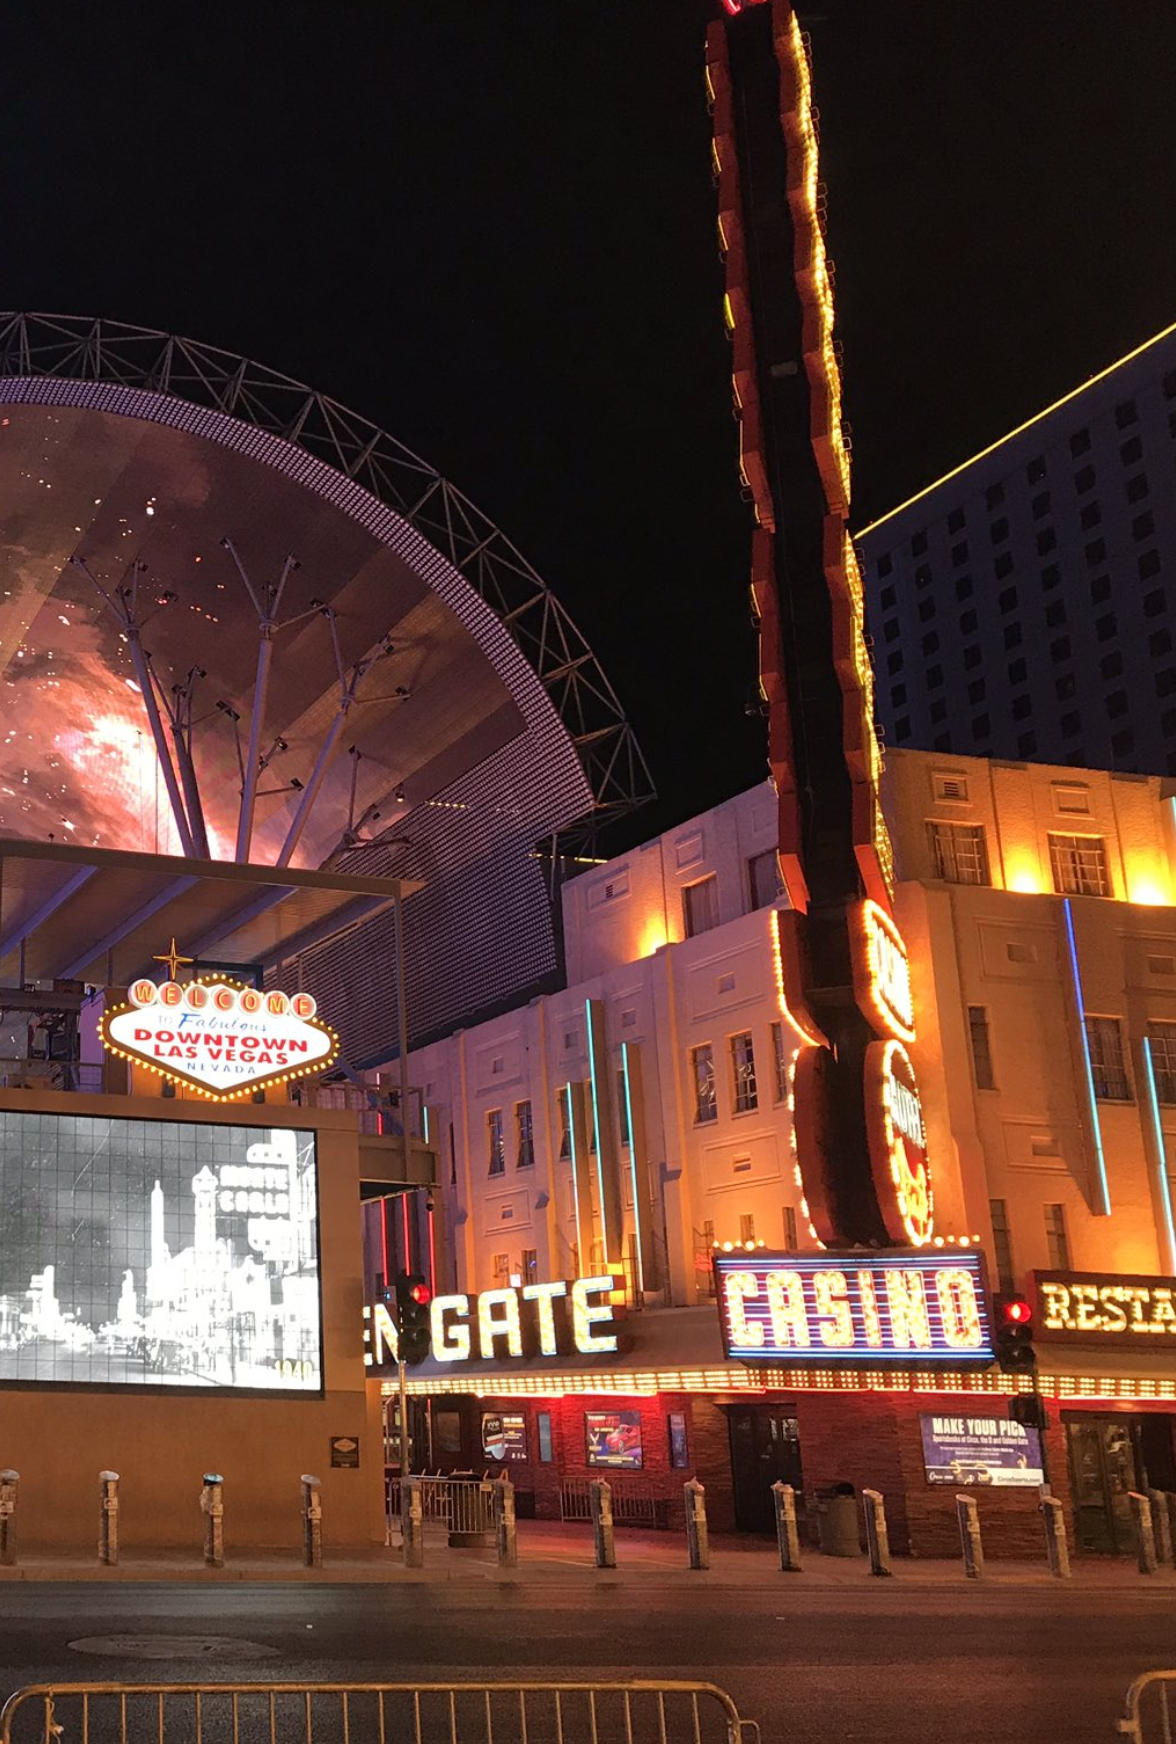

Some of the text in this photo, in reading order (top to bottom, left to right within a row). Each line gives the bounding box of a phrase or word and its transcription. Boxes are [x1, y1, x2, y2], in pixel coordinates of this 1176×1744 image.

[135, 984, 311, 1016] WELCOME
[178, 1012, 267, 1032] Fabulous
[134, 1028, 308, 1053] DOWNTOWN
[154, 1044, 289, 1066] LAS VEGAS
[187, 1062, 257, 1075] NEVADA
[430, 1275, 619, 1362] GATE
[724, 1269, 984, 1349] CASINO
[932, 1417, 965, 1435] MAKE
[967, 1418, 998, 1436] YOUR
